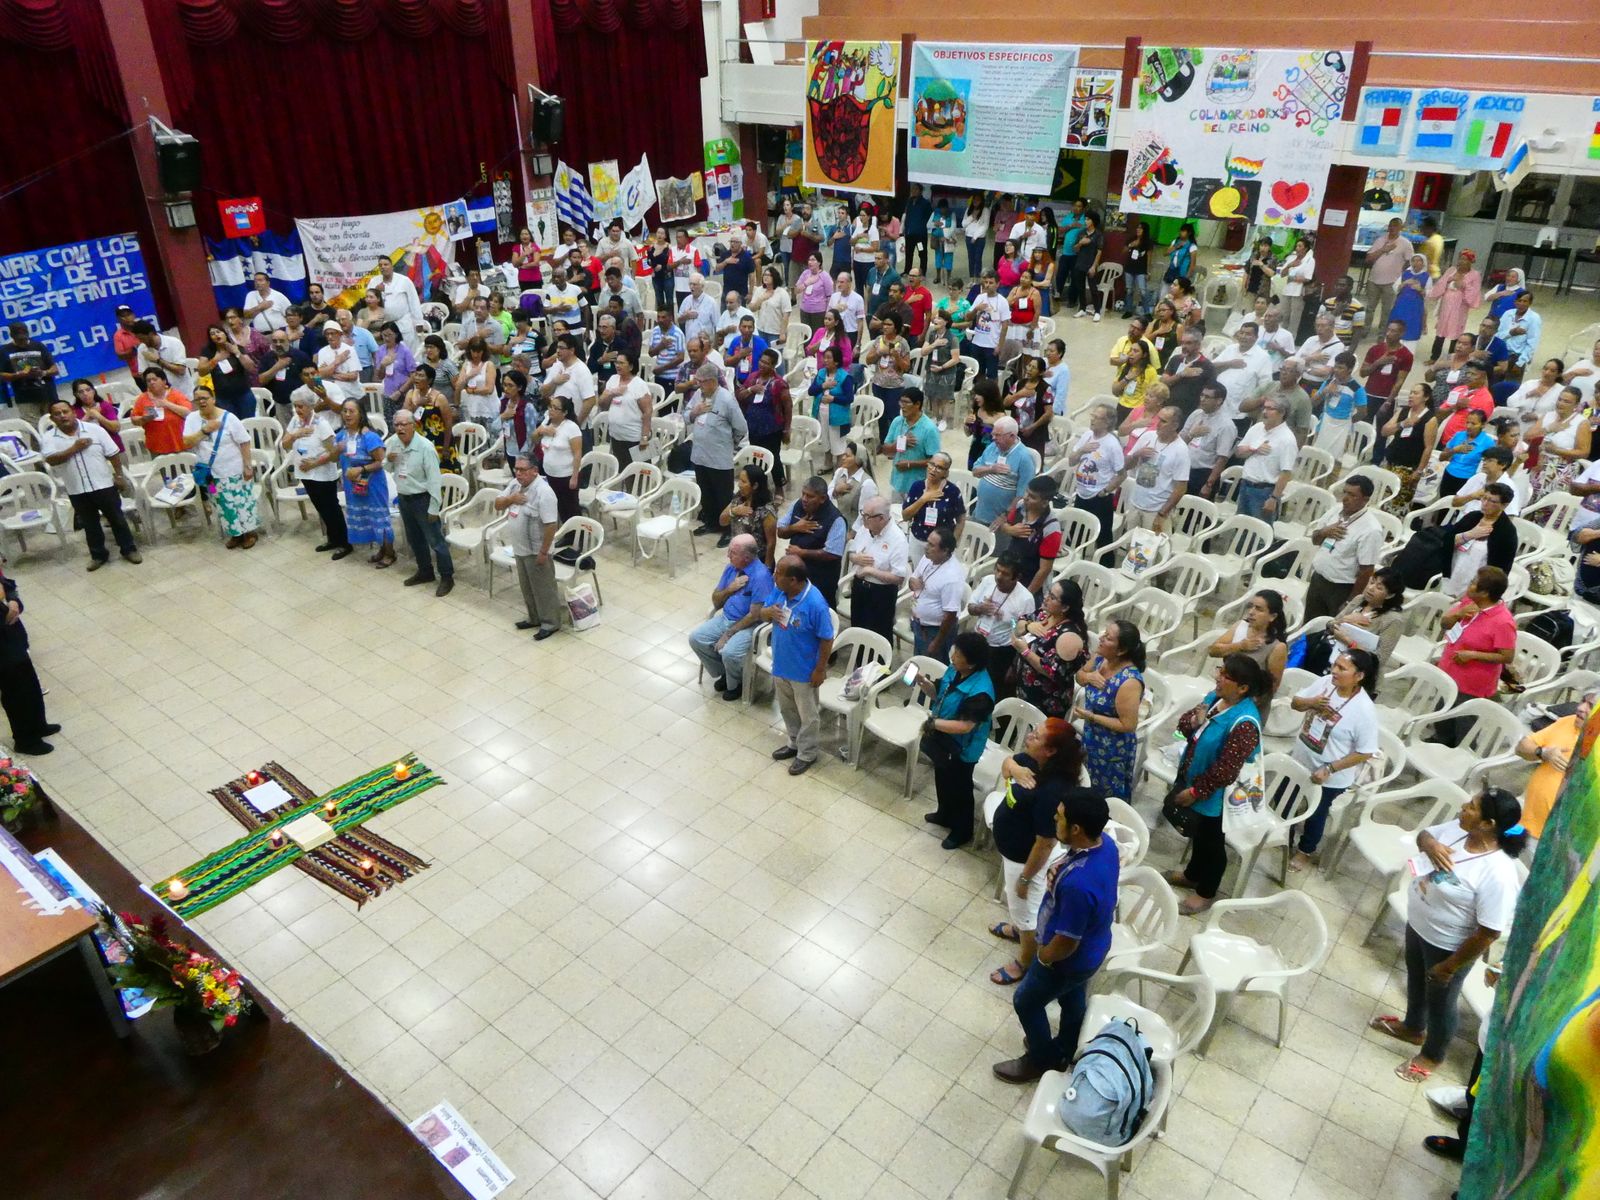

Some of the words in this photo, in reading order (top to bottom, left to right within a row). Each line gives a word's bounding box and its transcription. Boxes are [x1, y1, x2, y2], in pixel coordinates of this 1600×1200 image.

[933, 50, 986, 60] OBJETIVOS
[989, 52, 1053, 62] ESPECIFICOS
[1204, 122, 1223, 133] DEL
[1228, 122, 1270, 133] REINO
[328, 232, 341, 240] nos
[342, 230, 371, 240] levanta
[96, 235, 140, 258] LOS
[358, 242, 368, 251] de
[369, 240, 385, 250] Dios
[40, 273, 52, 291] Y
[64, 261, 98, 284] DE
[103, 256, 131, 277] LA
[2, 272, 147, 320] DESAFIANTES
[79, 324, 109, 348] LA
